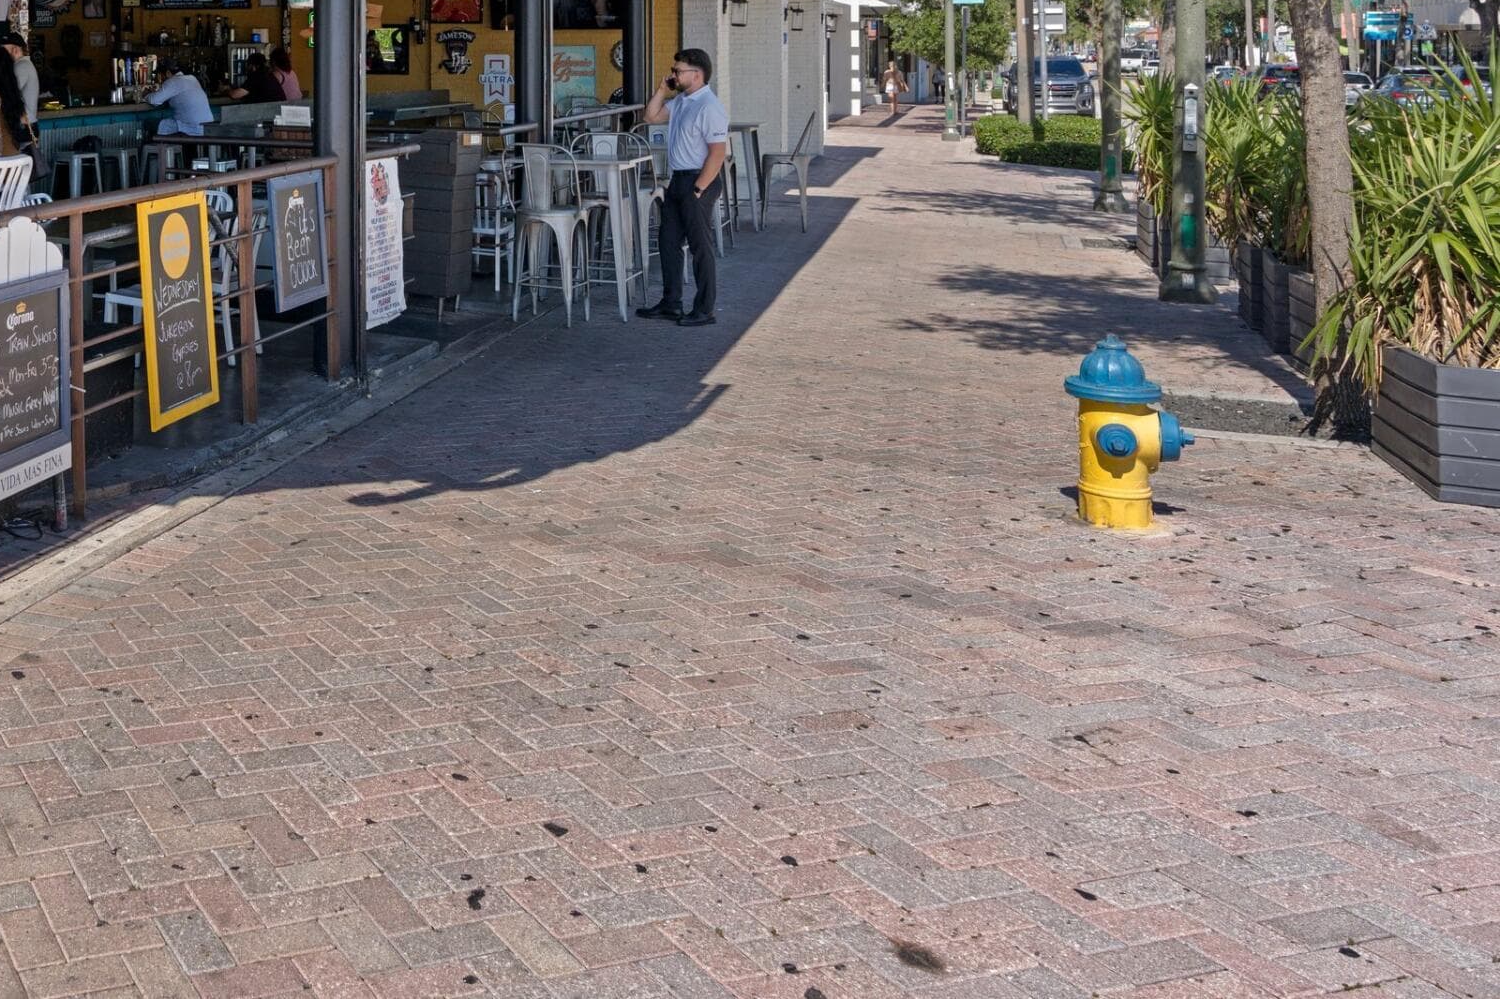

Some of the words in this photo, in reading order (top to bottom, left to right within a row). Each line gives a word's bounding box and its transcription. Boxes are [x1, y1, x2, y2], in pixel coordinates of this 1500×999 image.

[438, 30, 475, 42] JAMESON
[479, 74, 513, 85] ULTRA
[286, 232, 311, 262] Beer
[154, 272, 200, 311] WEDNESDAY
[6, 311, 34, 331] Corona
[158, 318, 195, 343] JUKEBOX
[0, 473, 21, 492] VIDA
[22, 462, 42, 481] MAS
[44, 453, 63, 473] FINA
